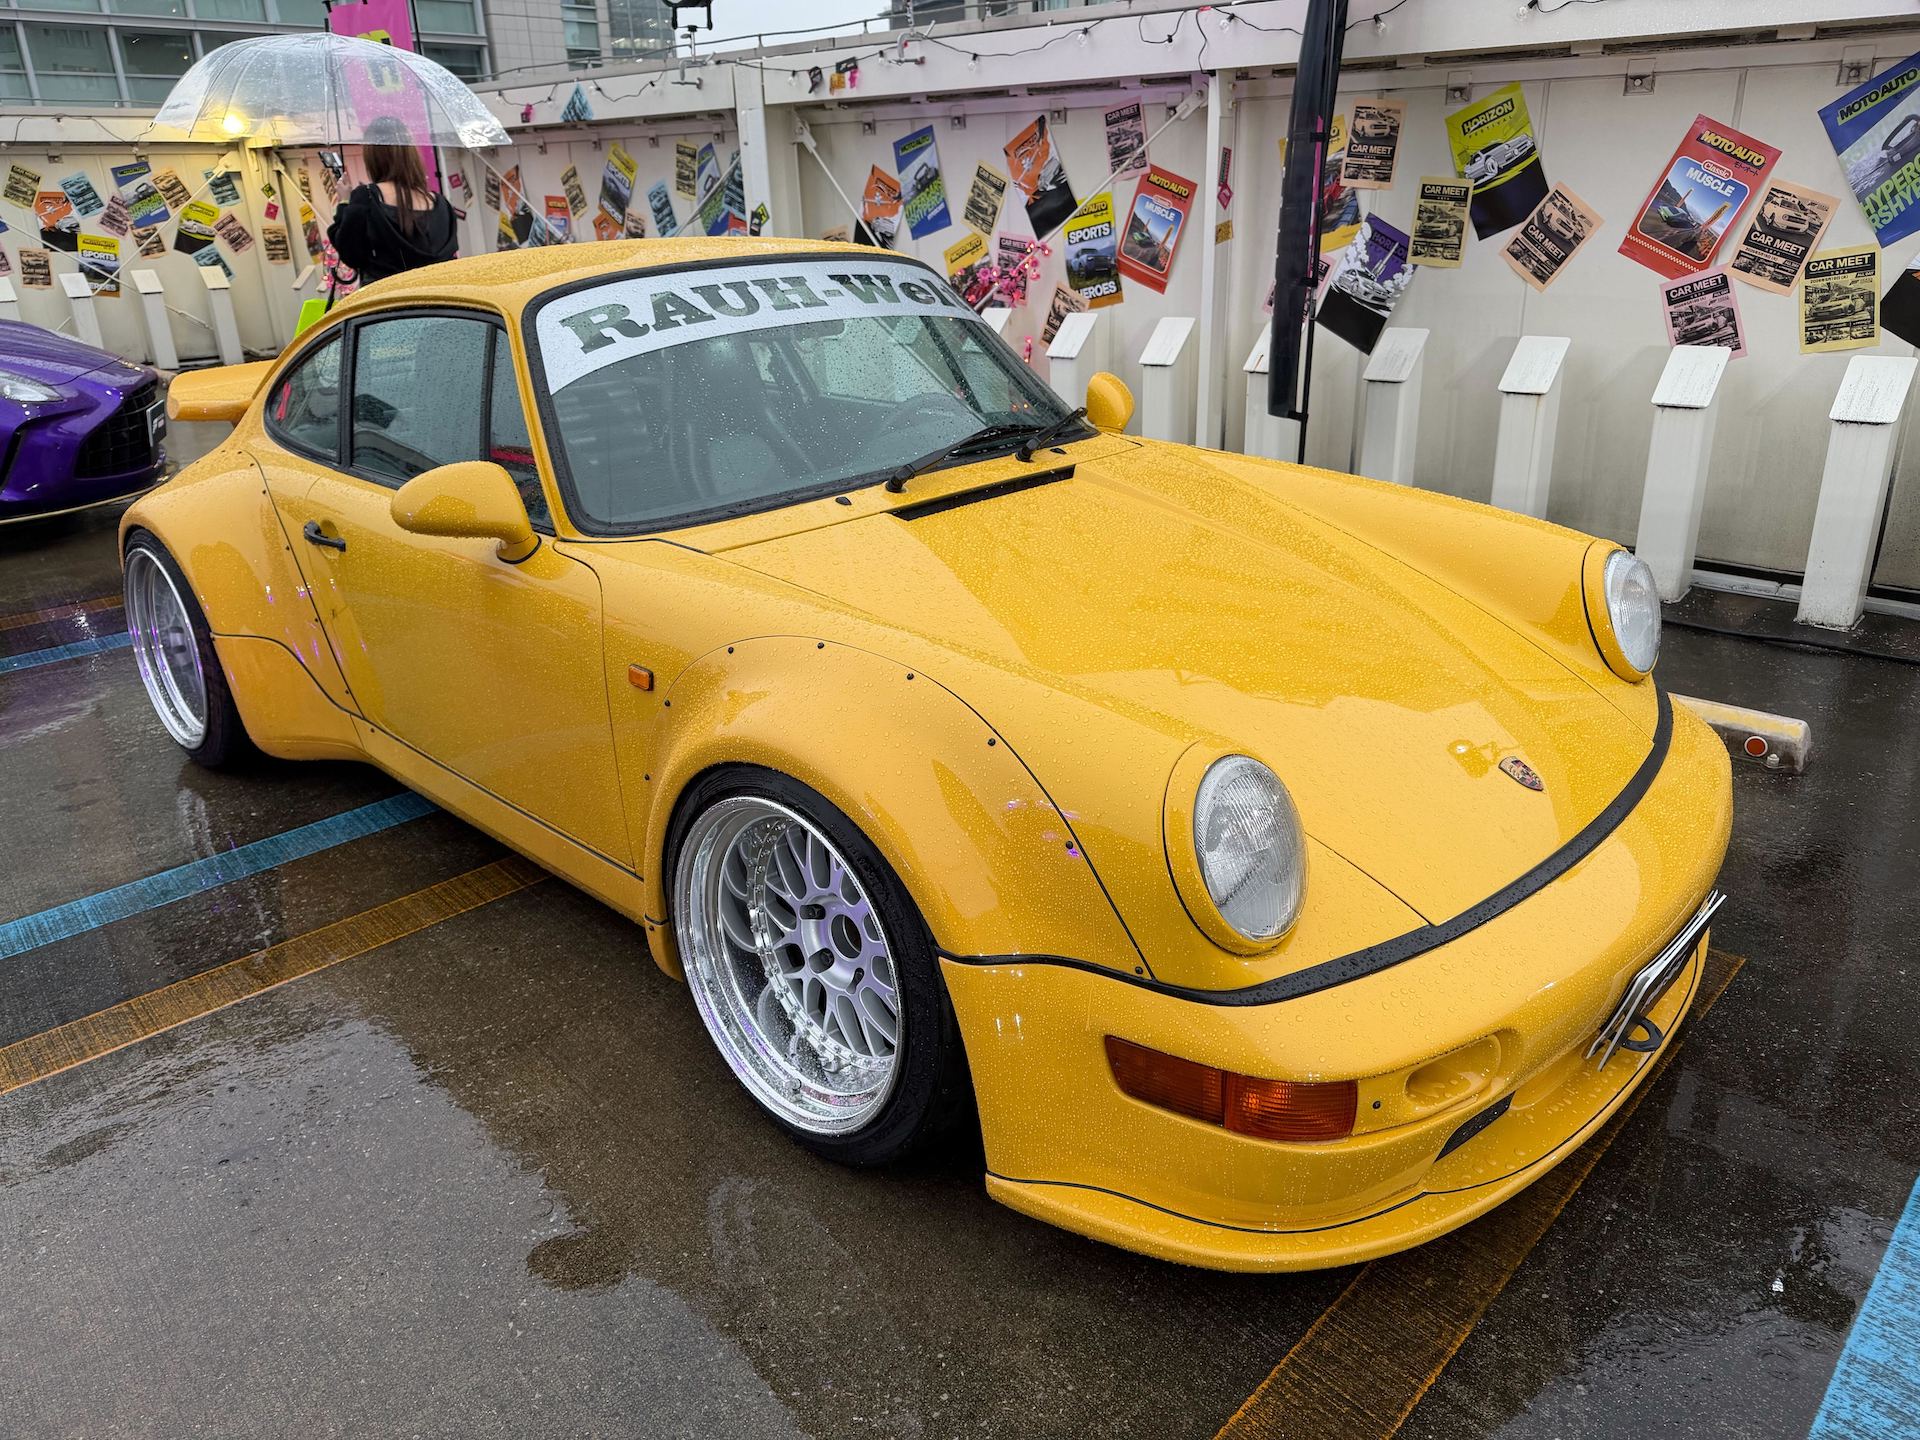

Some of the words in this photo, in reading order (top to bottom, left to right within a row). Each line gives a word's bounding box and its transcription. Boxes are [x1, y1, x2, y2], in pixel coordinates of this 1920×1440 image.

[1839, 90, 1880, 120] MOTO
[1880, 68, 1918, 97] AUTO
[1463, 100, 1513, 133] HORIZON
[1350, 144, 1368, 153] CAR
[1368, 145, 1393, 155] MEET
[1701, 130, 1736, 153] MOTO
[1731, 146, 1766, 167] AUTO
[1686, 167, 1736, 197] MUSCLE
[1704, 162, 1730, 179] Classic
[1149, 174, 1170, 189] MOTO
[1169, 182, 1189, 197] AUTO
[1424, 185, 1442, 194] CAR
[1442, 186, 1467, 196] MEET
[1145, 201, 1175, 222] MUSCLE
[1069, 223, 1110, 245] SPORTS
[1527, 224, 1545, 240] CAR
[1542, 238, 1565, 259] MEET
[1750, 231, 1774, 246] CAR
[1774, 238, 1806, 256] MEET
[82, 250, 116, 261] SPORTS
[1809, 259, 1834, 272] CAR
[1836, 254, 1872, 267] MEET
[1669, 285, 1692, 299] CAR
[1693, 275, 1723, 291] MEET
